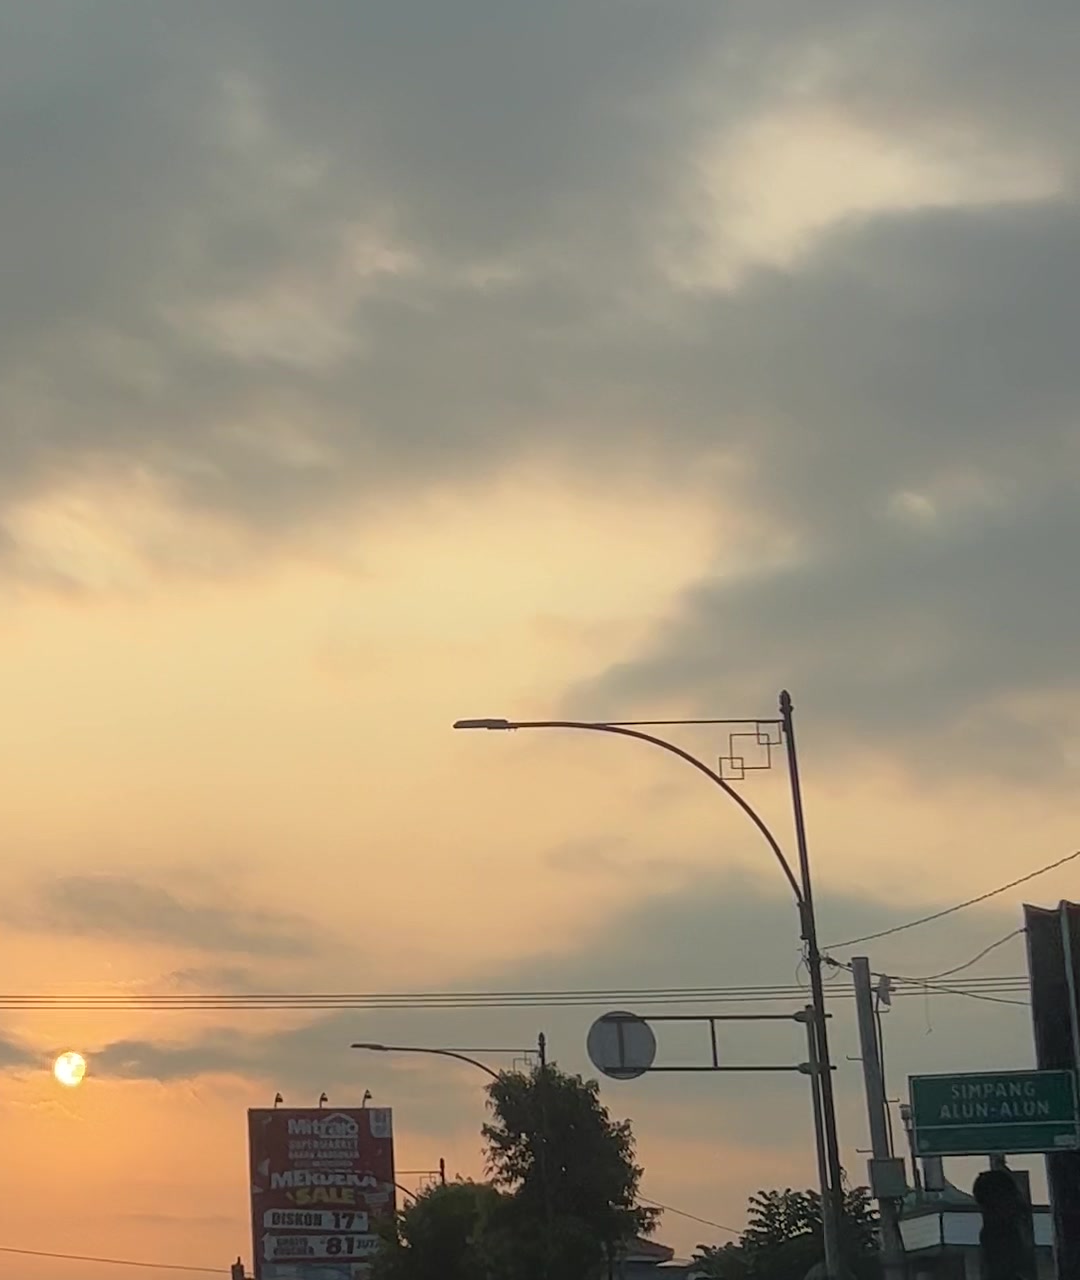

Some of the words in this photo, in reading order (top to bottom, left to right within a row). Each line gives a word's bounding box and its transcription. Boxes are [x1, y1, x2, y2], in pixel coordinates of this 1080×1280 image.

[951, 1081, 1036, 1100] SIMPANG
[939, 1100, 1050, 1120] ALUN-ALUN
[296, 1186, 356, 1205] SALE
[272, 1212, 323, 1227] DISKON
